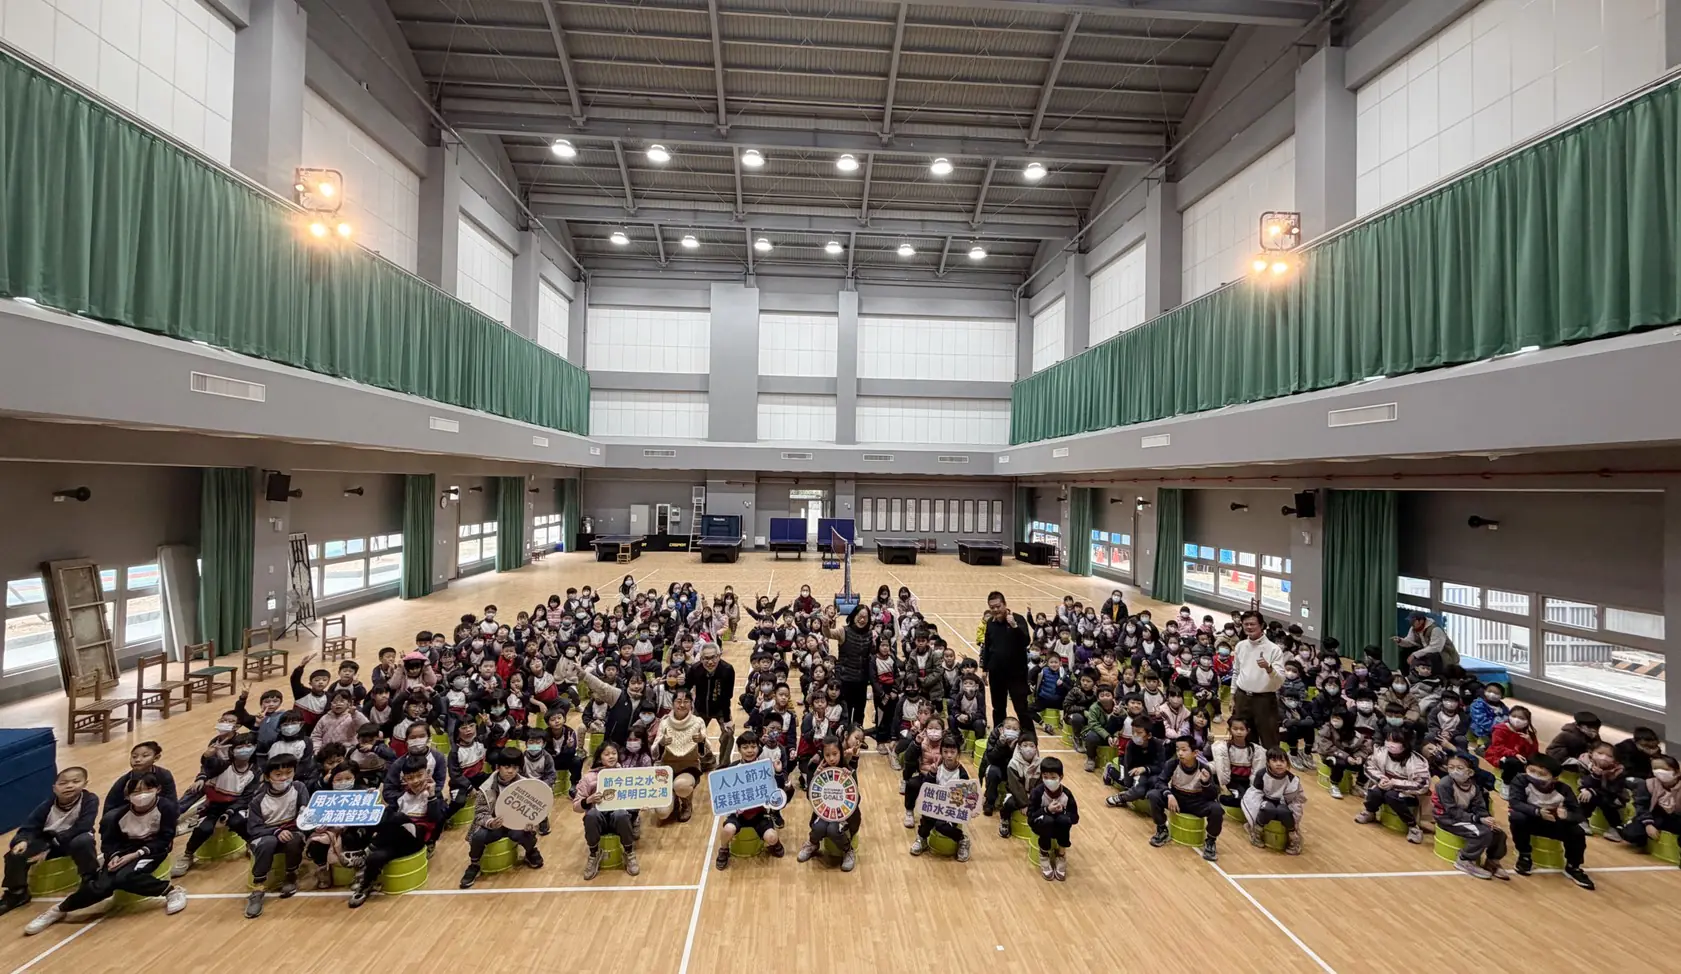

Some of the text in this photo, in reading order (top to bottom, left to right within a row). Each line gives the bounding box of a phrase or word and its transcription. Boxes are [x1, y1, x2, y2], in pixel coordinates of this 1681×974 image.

[604, 775, 655, 788] 節今日之水
[719, 766, 772, 790] 人人節水
[312, 794, 374, 807] 用水不浪費
[511, 790, 543, 813] DEVELOPMENT
[515, 786, 547, 809] SUSTAINABLE
[714, 784, 768, 810] 保護環境
[924, 786, 948, 802] 做個
[320, 809, 381, 823] 滴滴皆珍貴
[504, 795, 538, 821] GOALS
[922, 800, 969, 821] 節水英雄
